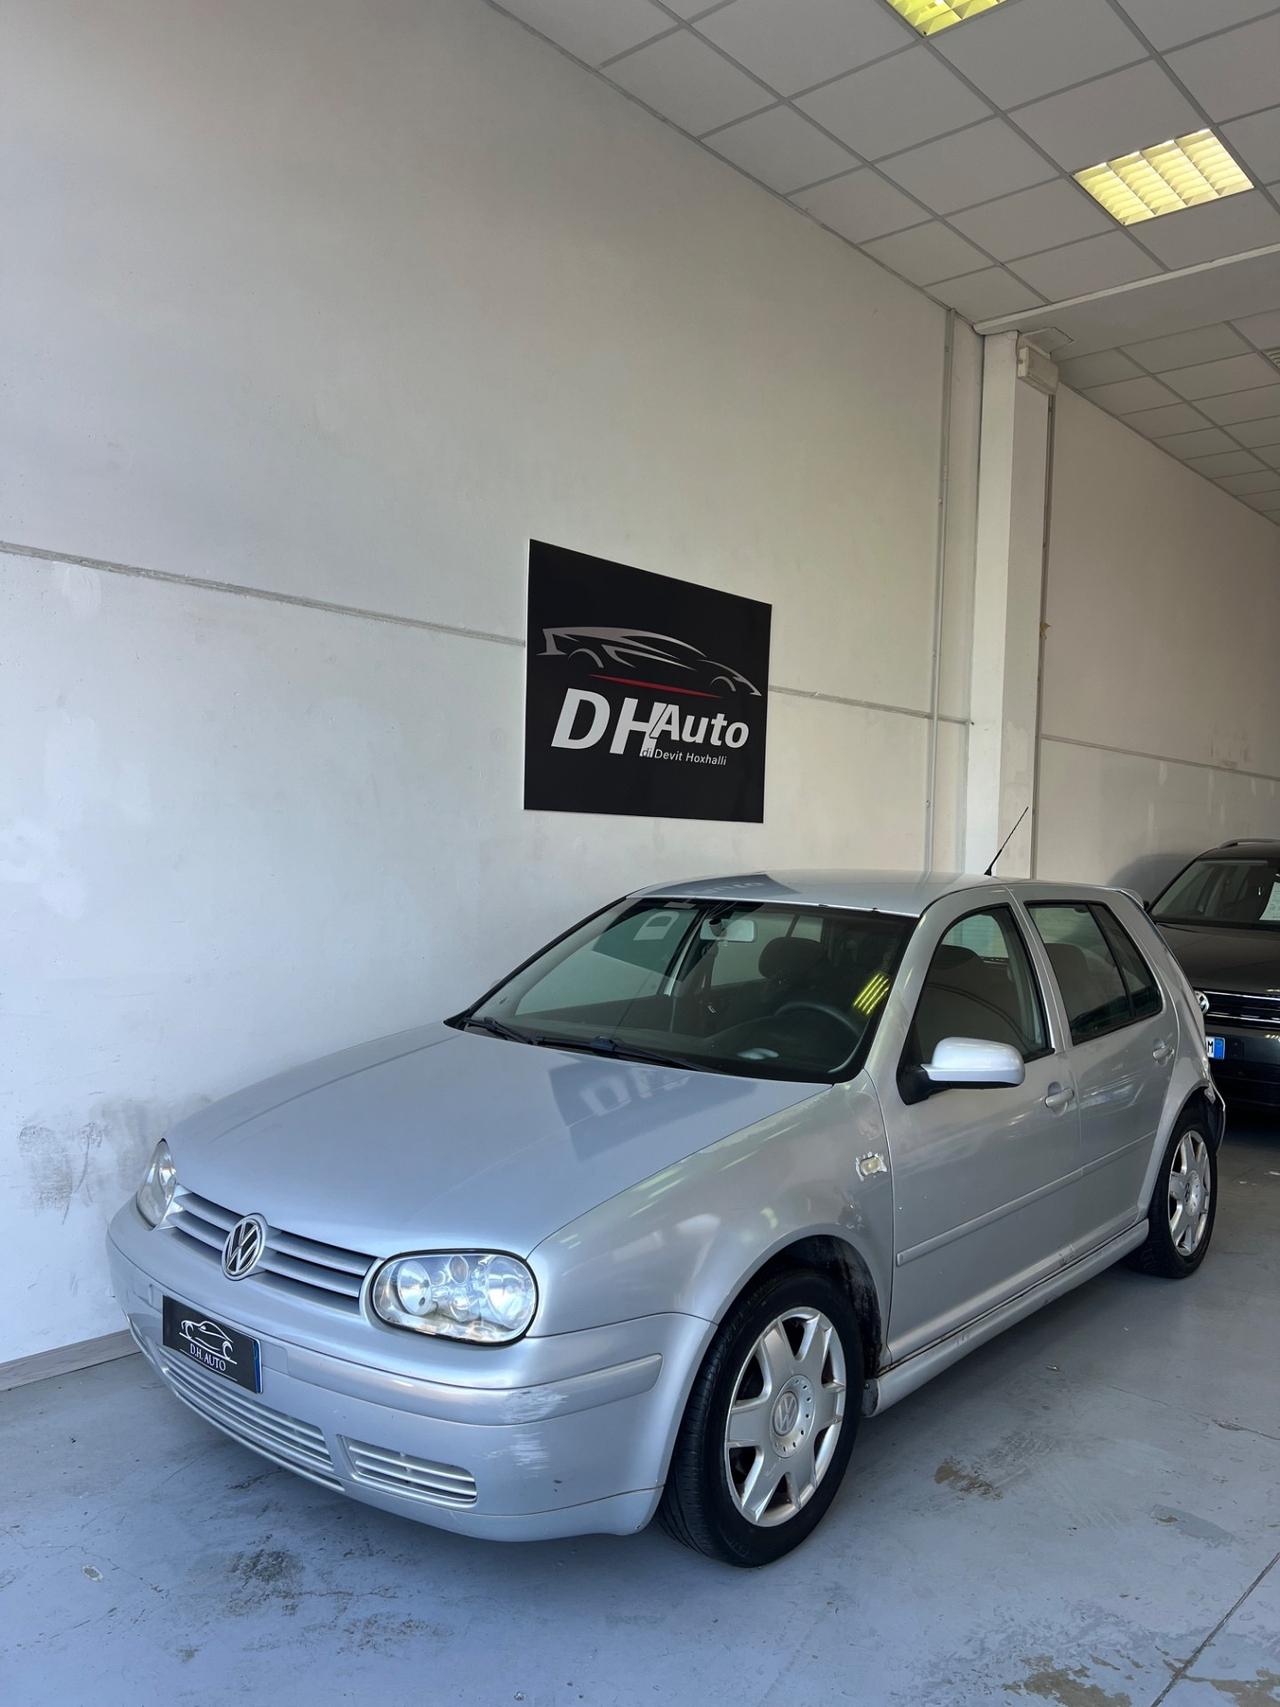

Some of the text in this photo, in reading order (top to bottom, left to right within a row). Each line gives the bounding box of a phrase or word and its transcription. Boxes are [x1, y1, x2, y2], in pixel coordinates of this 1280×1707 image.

[649, 703, 750, 749] Auto
[654, 748, 683, 761] Devit
[685, 752, 728, 766] Hoxhalli
[190, 1343, 226, 1372] D.H. AUTO
